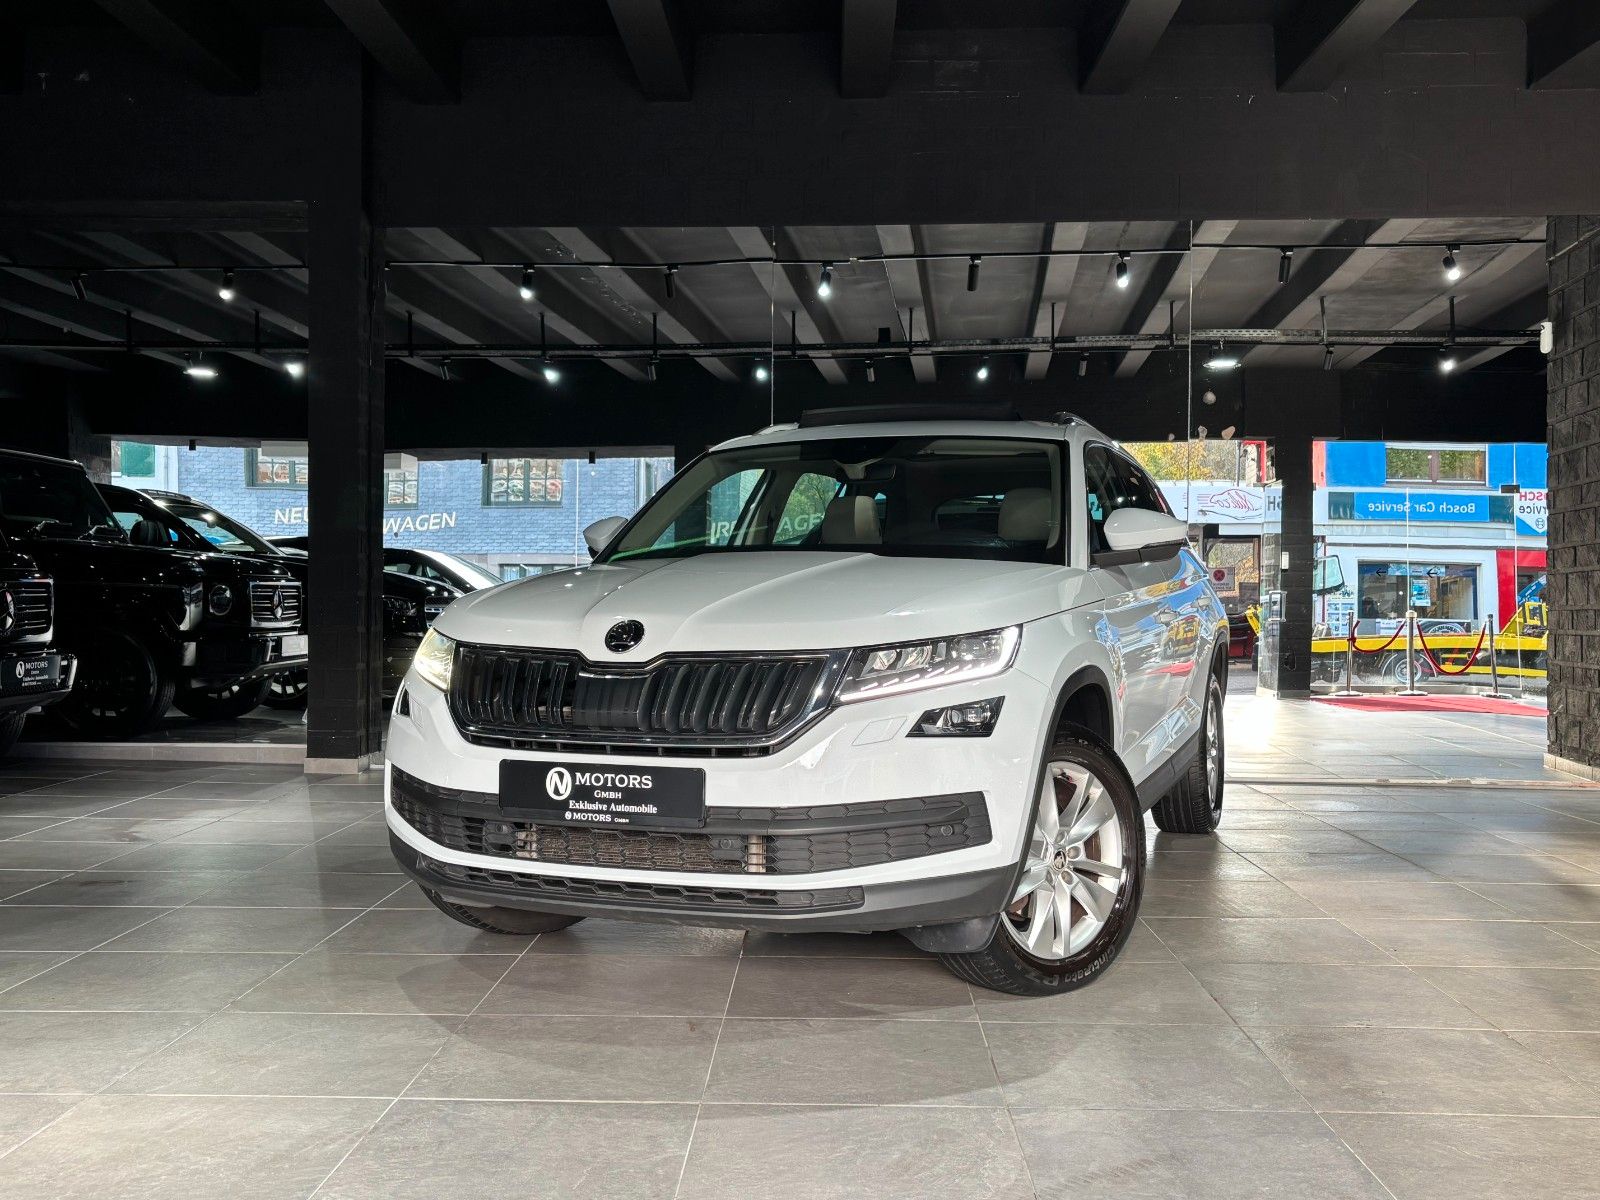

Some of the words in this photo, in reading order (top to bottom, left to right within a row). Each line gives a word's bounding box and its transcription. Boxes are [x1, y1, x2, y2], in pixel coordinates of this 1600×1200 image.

[383, 511, 457, 534] WAGEN
[575, 772, 653, 789] MOTORS
[569, 800, 608, 811] Exklusive
[609, 802, 658, 814] Automobile
[573, 812, 612, 822] MOTORS
